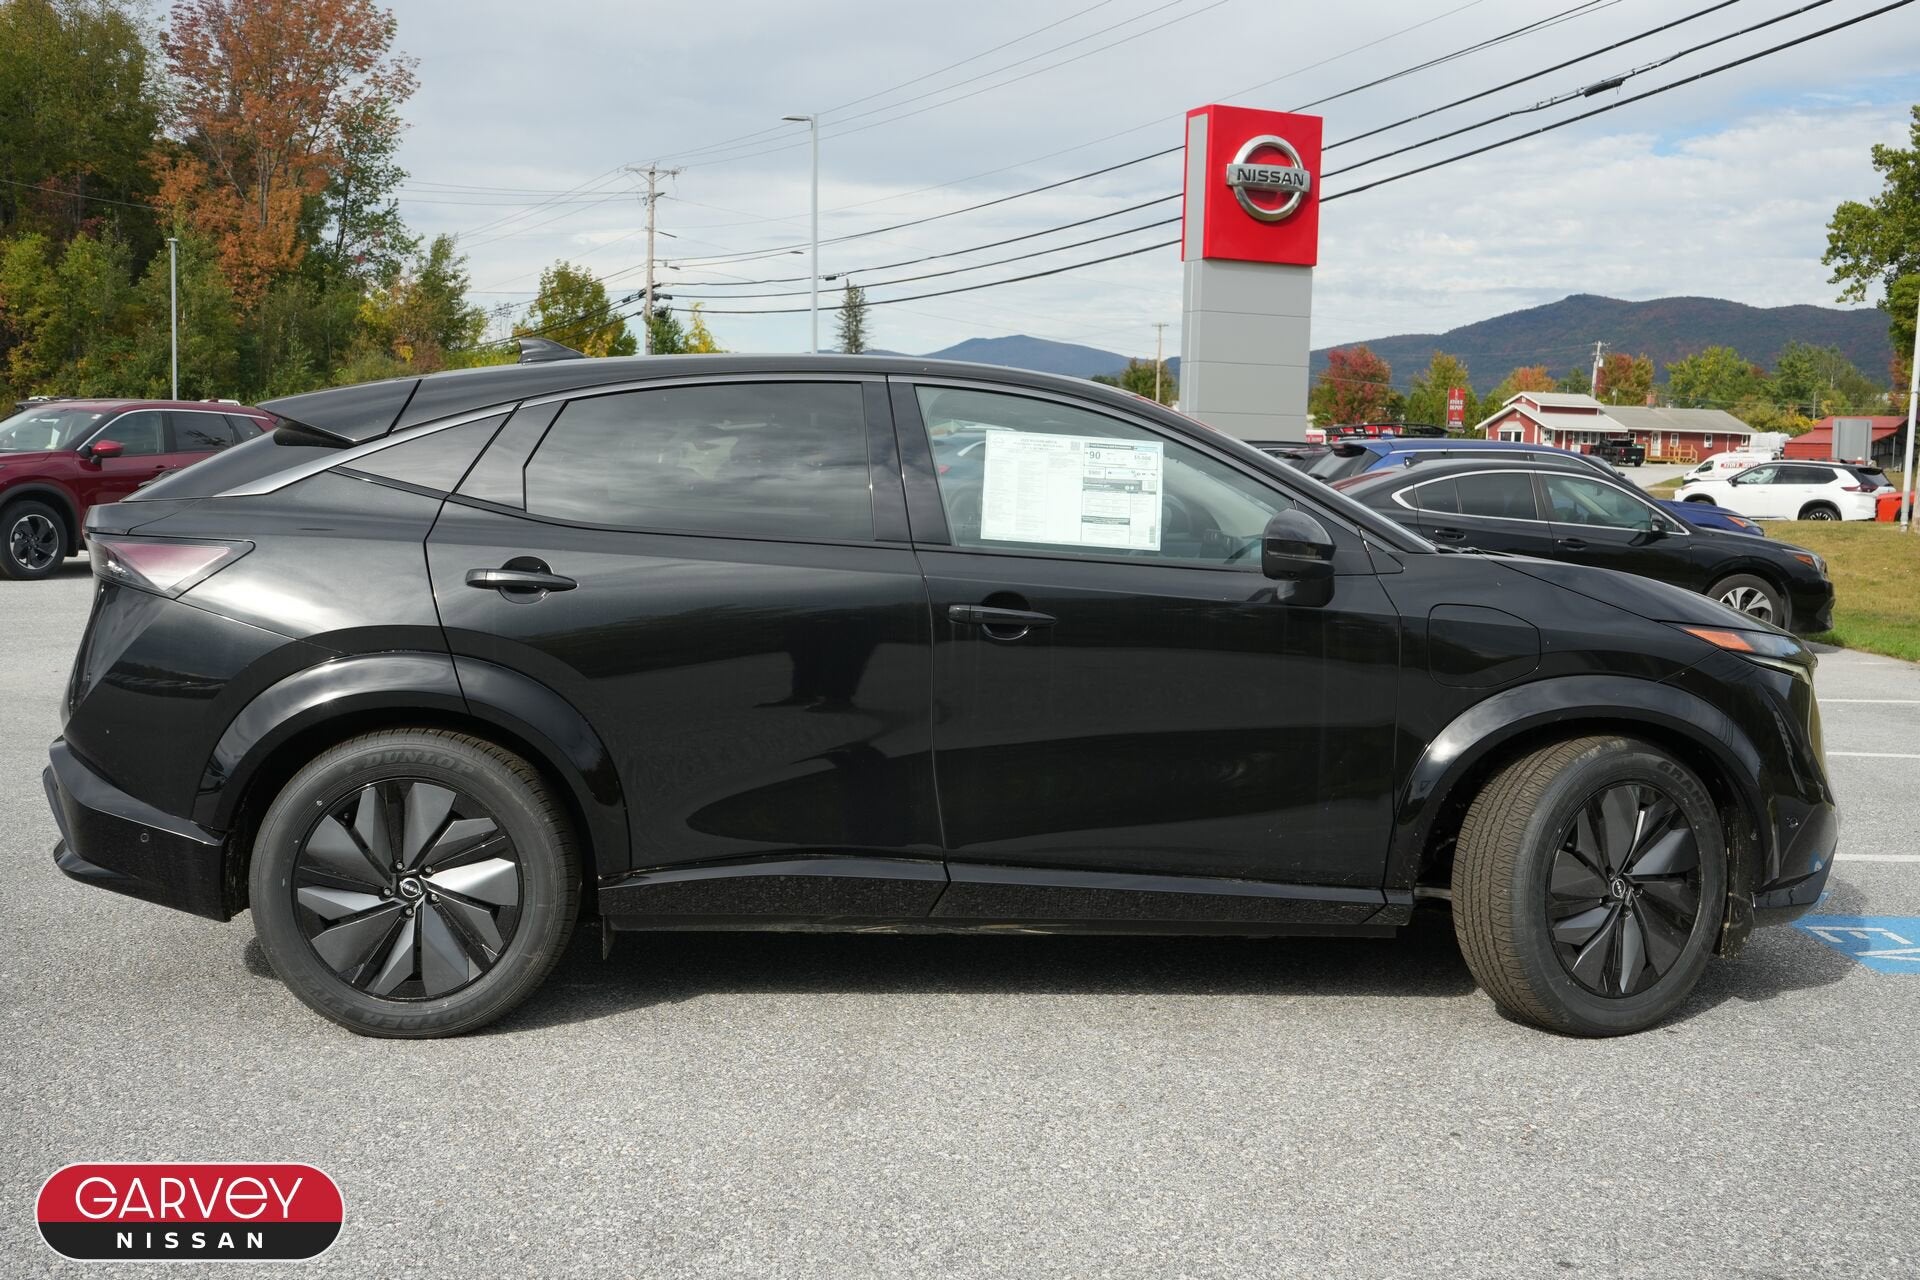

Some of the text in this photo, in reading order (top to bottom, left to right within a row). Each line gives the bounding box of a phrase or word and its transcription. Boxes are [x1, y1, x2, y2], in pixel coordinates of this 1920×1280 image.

[1237, 168, 1304, 186] NISSAN
[1089, 451, 1101, 459] 90
[364, 750, 474, 773] DUNLOP
